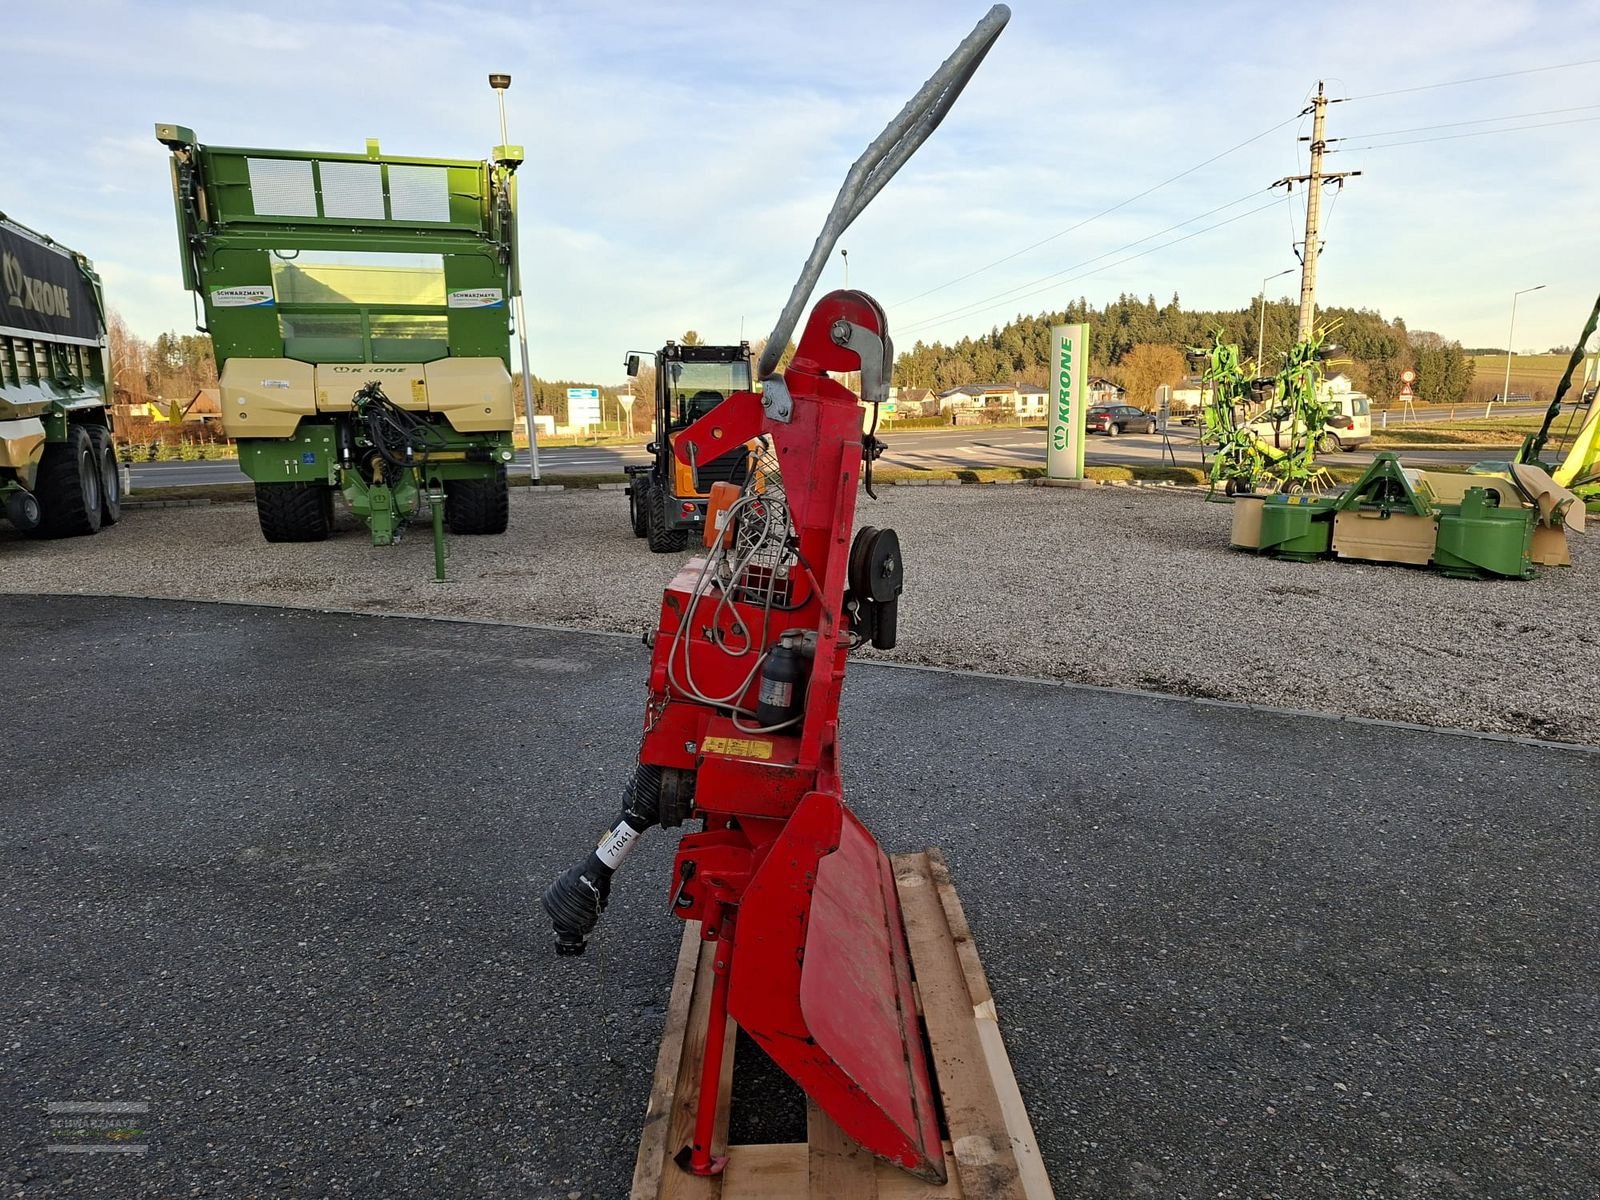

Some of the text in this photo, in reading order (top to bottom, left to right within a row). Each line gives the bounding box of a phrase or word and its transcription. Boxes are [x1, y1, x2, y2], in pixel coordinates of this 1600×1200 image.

[23, 275, 71, 319] KRONE
[1059, 337, 1072, 423] KRONE
[607, 831, 632, 857] 71041
